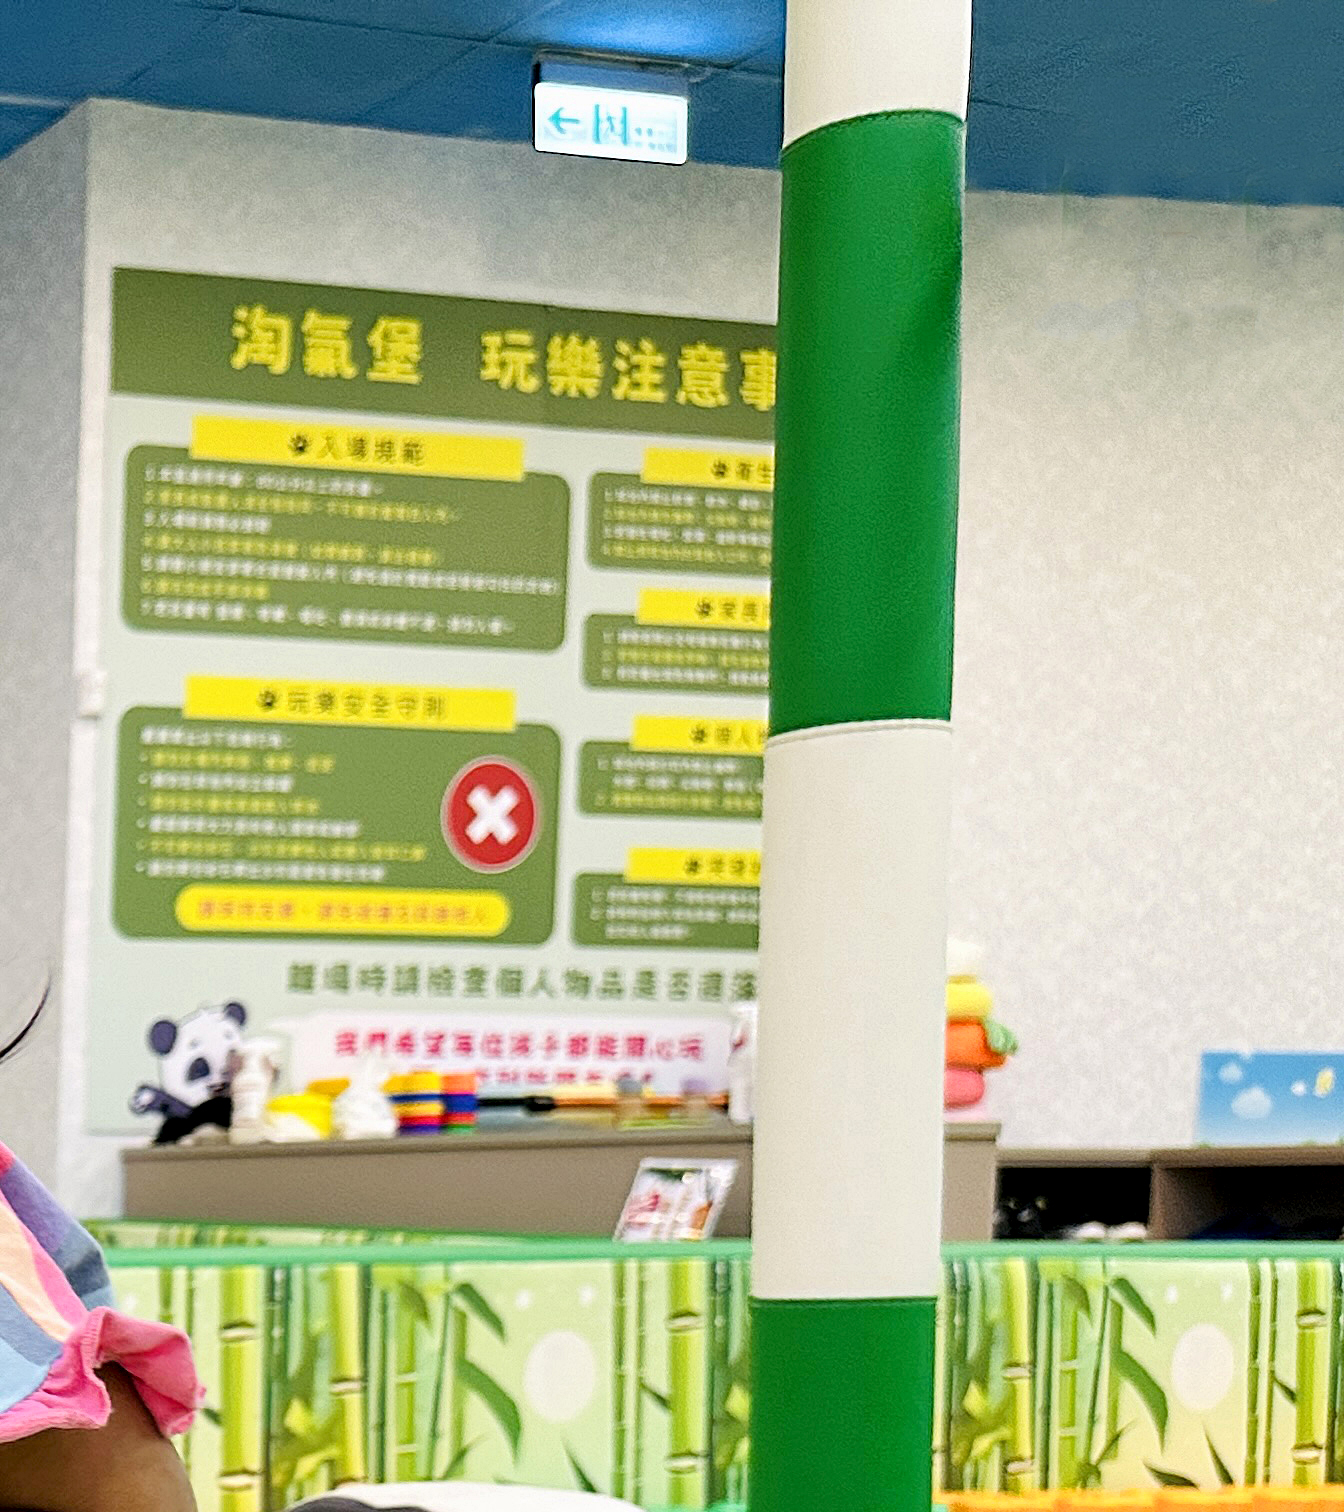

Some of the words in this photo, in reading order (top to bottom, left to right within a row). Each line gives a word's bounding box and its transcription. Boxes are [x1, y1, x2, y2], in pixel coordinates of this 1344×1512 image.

[230, 303, 423, 385] 淘氣堡
[480, 328, 776, 411] 玩樂注意事
